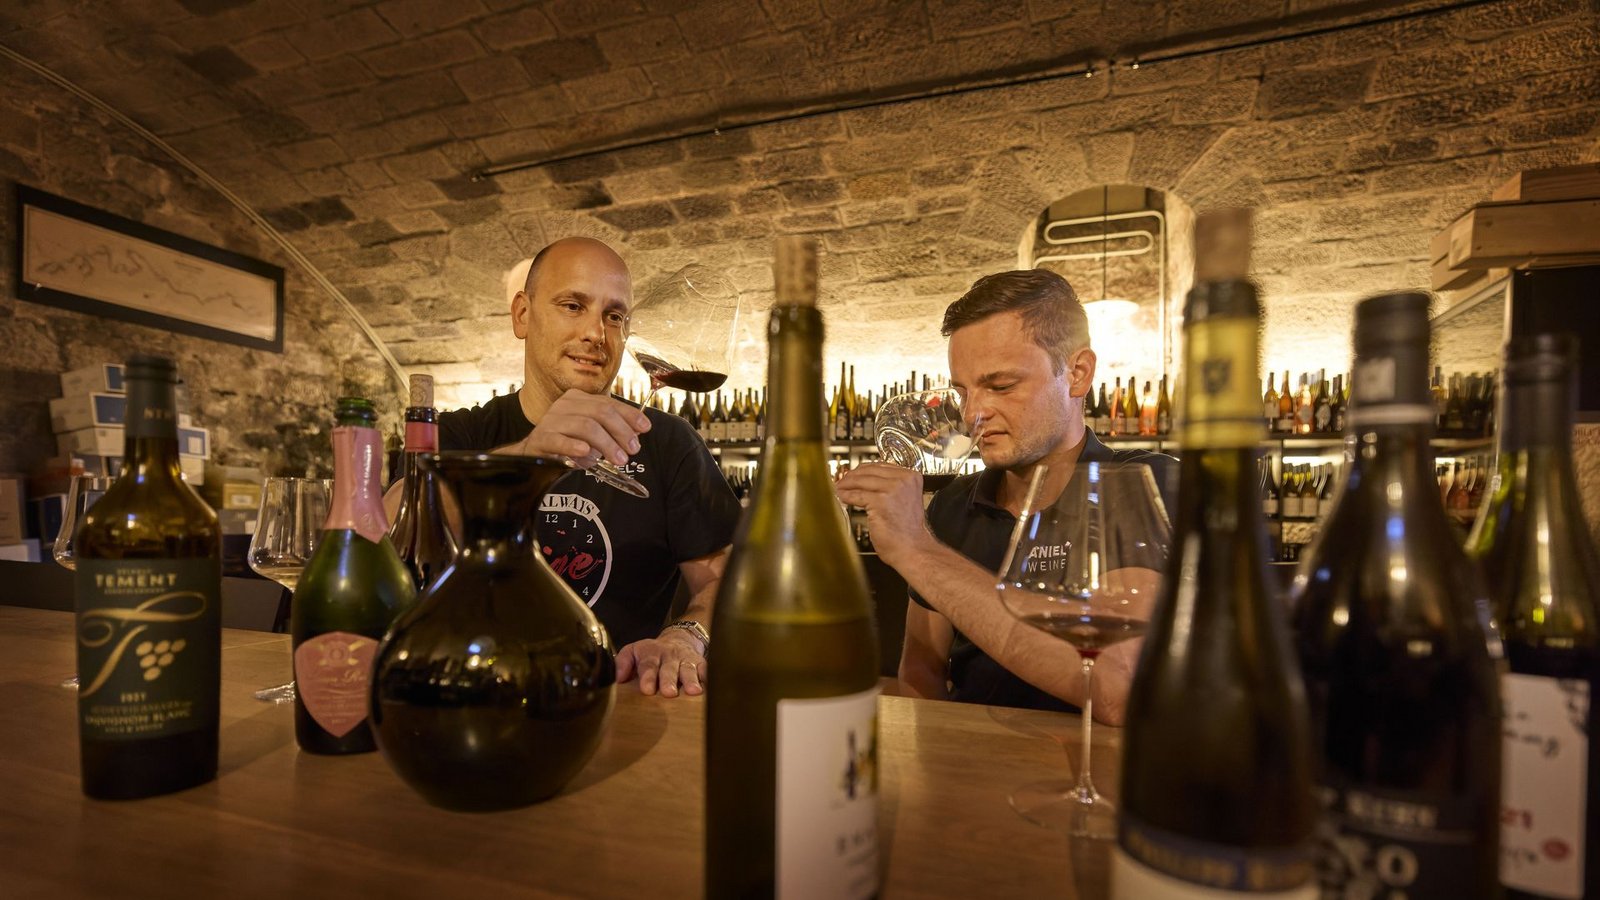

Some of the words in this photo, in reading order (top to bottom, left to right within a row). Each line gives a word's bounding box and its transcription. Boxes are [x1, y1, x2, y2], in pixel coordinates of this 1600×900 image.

[545, 514, 559, 523] 12
[573, 519, 578, 528] 1
[586, 534, 594, 544] 2
[1028, 559, 1066, 573] WEINE
[95, 574, 177, 587] TEMENT
[582, 586, 589, 596] 4
